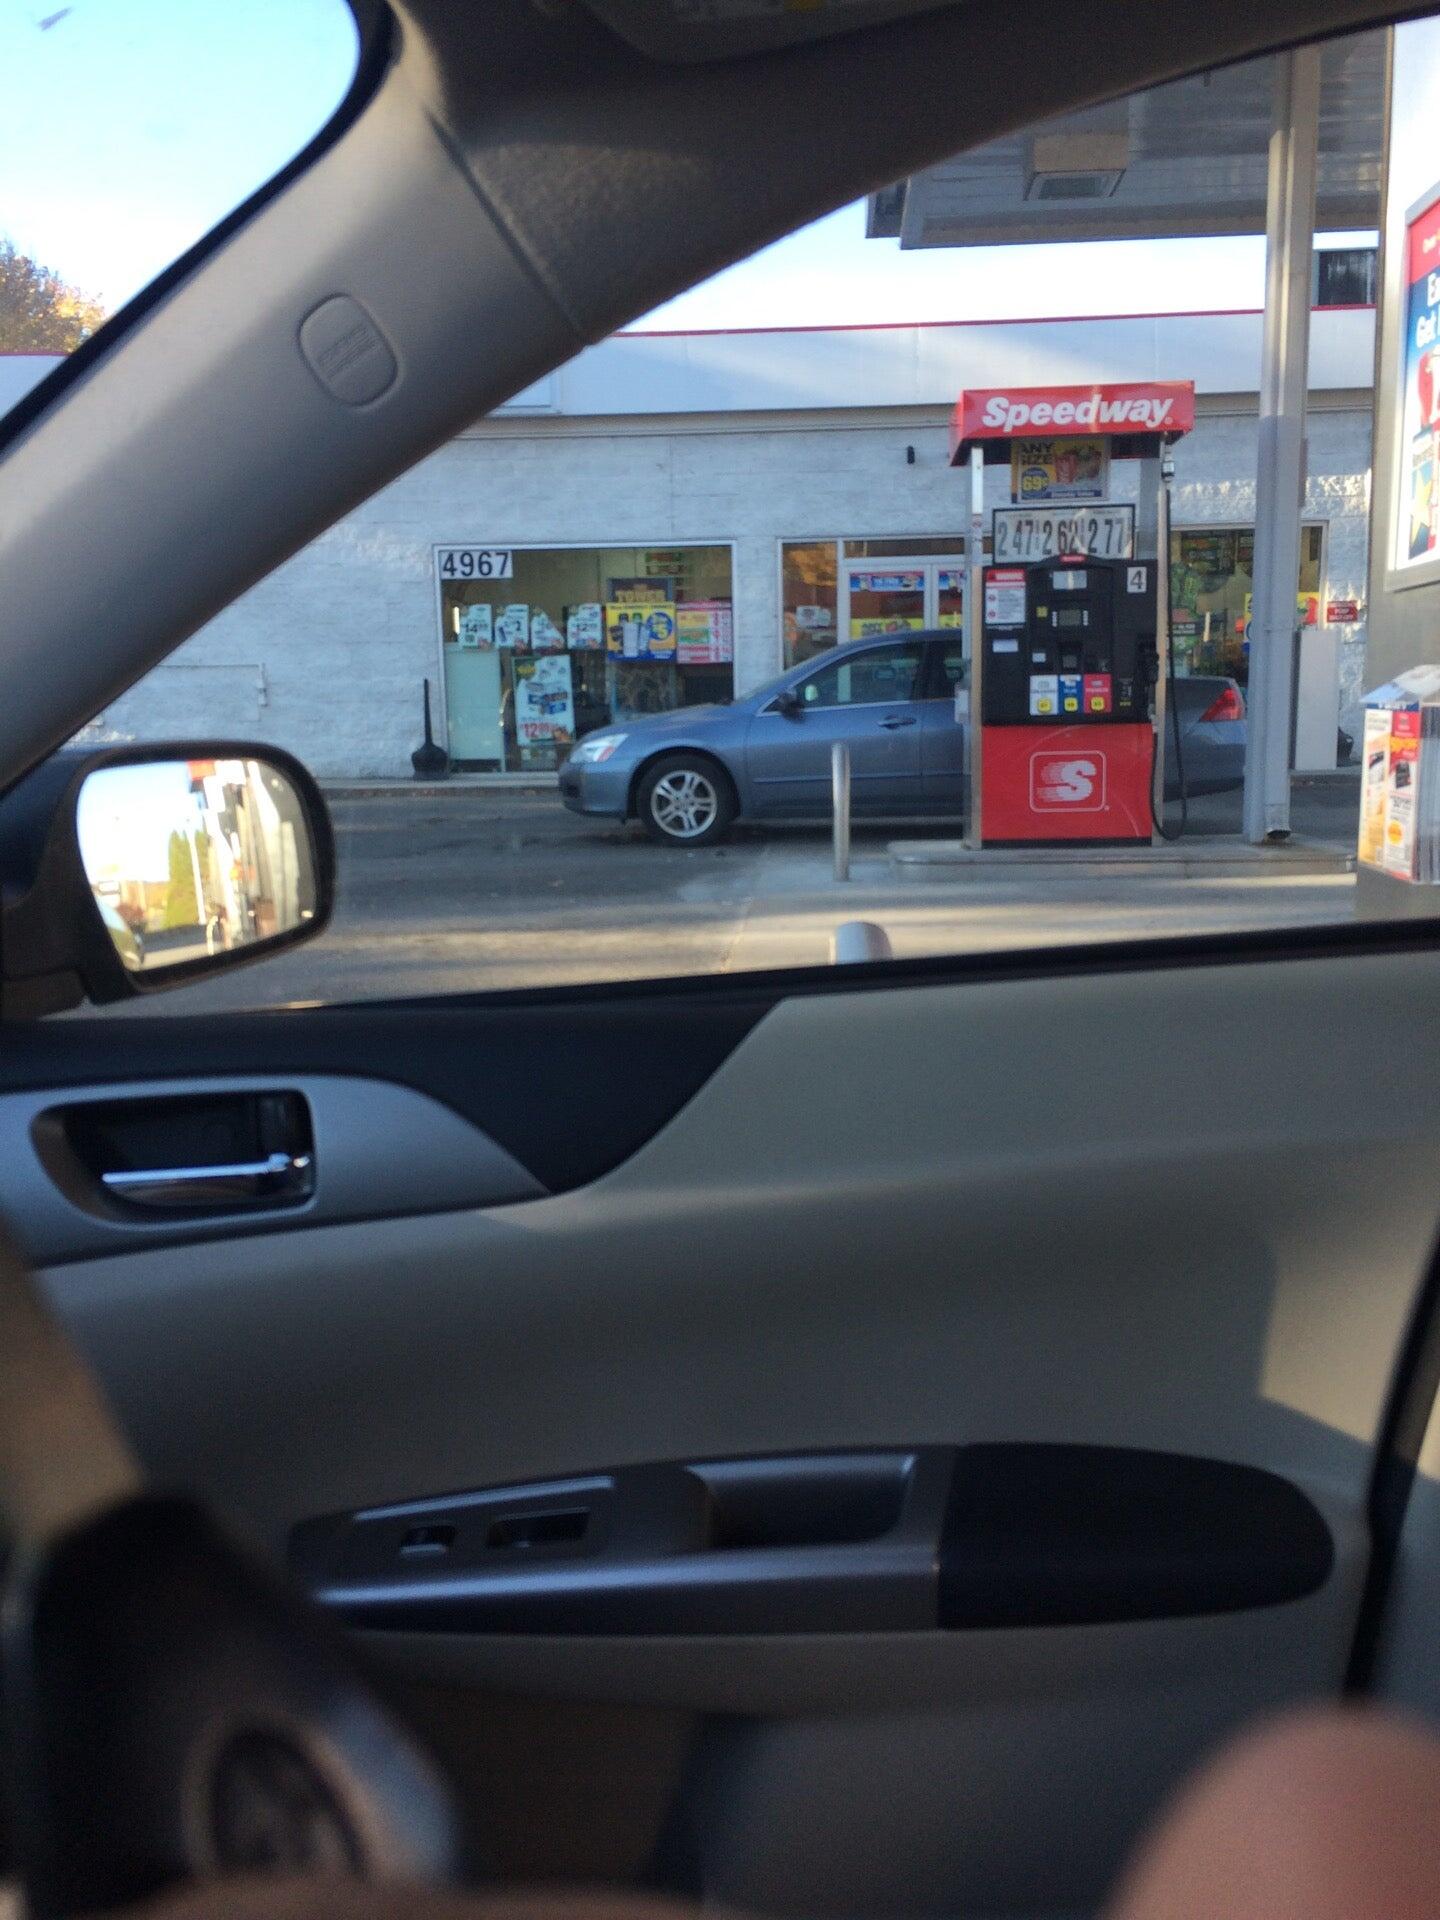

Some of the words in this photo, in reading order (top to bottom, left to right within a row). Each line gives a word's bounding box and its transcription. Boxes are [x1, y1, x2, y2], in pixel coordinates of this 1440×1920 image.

[982, 394, 1173, 432] Speedway
[442, 551, 509, 577] 4967
[1130, 569, 1144, 590] 4
[1040, 760, 1097, 802] S
